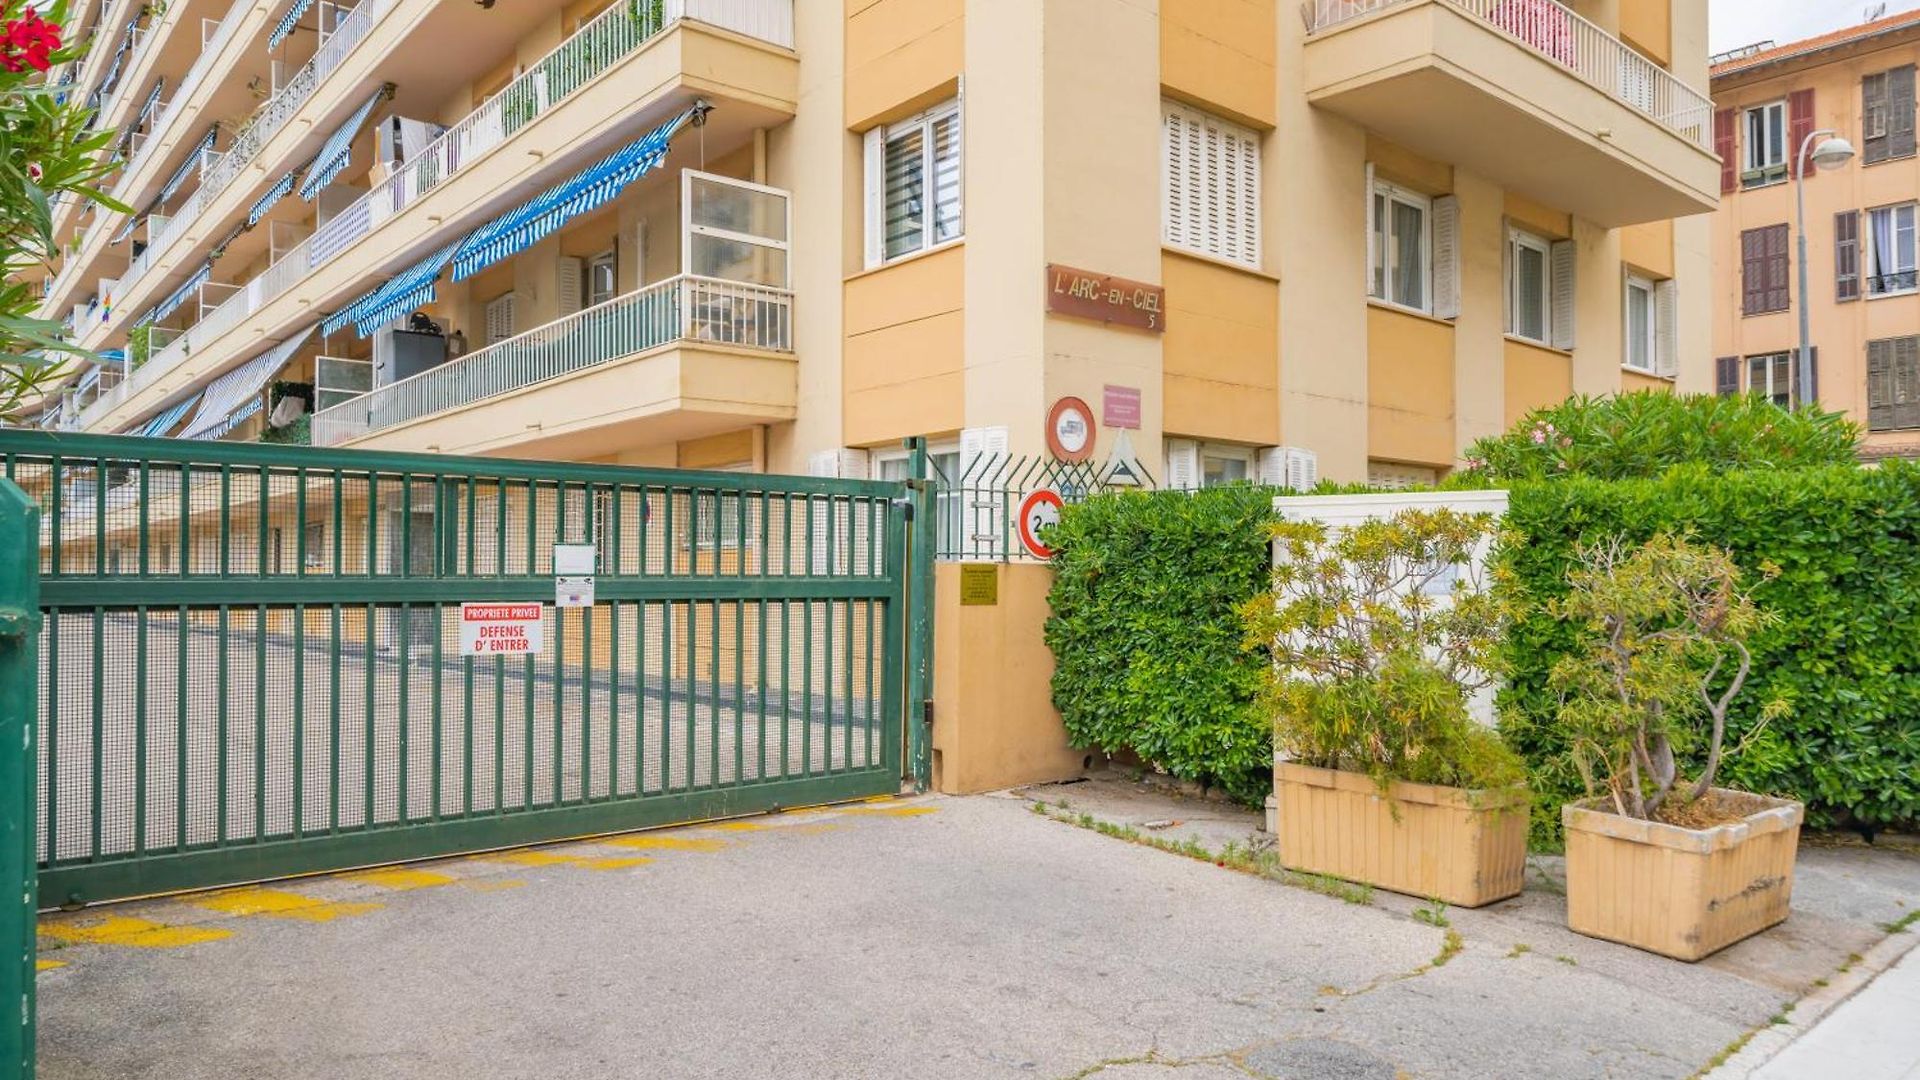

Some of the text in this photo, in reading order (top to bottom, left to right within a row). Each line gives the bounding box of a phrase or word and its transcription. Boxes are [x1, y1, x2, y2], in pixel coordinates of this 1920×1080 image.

[1147, 315, 1155, 328] 5
[467, 607, 538, 620] PROPRIETE PRIVEE
[480, 625, 525, 638] DEFENSE
